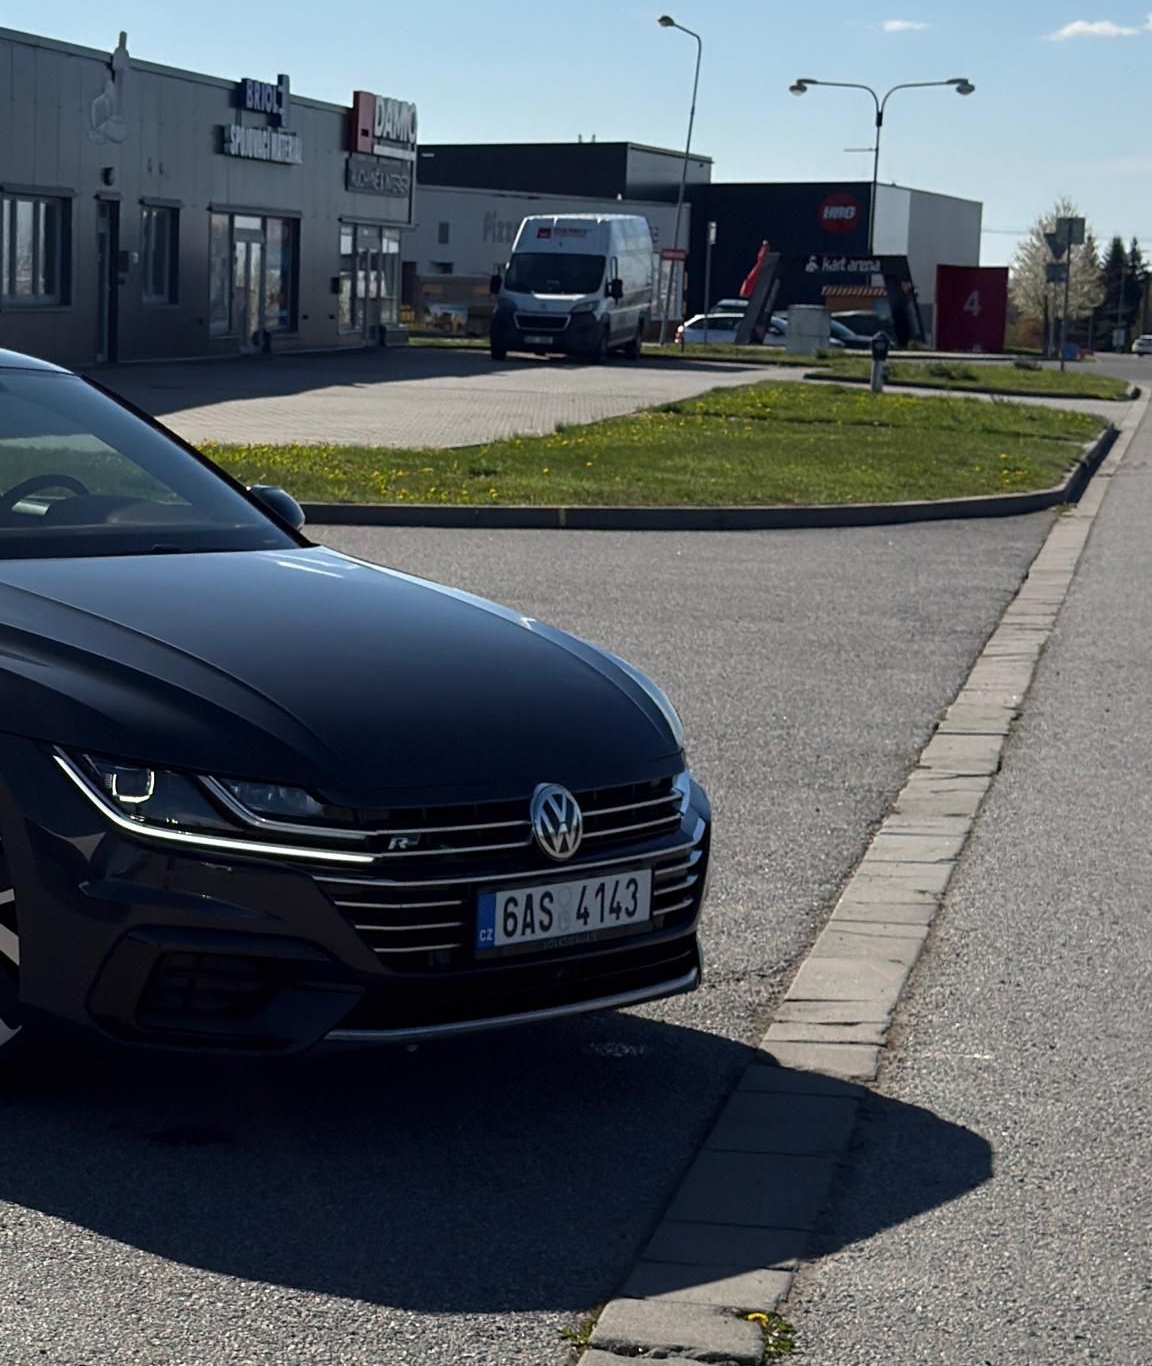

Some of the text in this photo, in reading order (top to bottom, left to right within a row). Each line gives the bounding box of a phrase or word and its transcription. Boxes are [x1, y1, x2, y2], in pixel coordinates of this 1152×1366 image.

[822, 256, 881, 273] kart arena
[963, 289, 982, 316] 4
[502, 877, 639, 939] 6AS 4143
[479, 928, 494, 942] CZ
